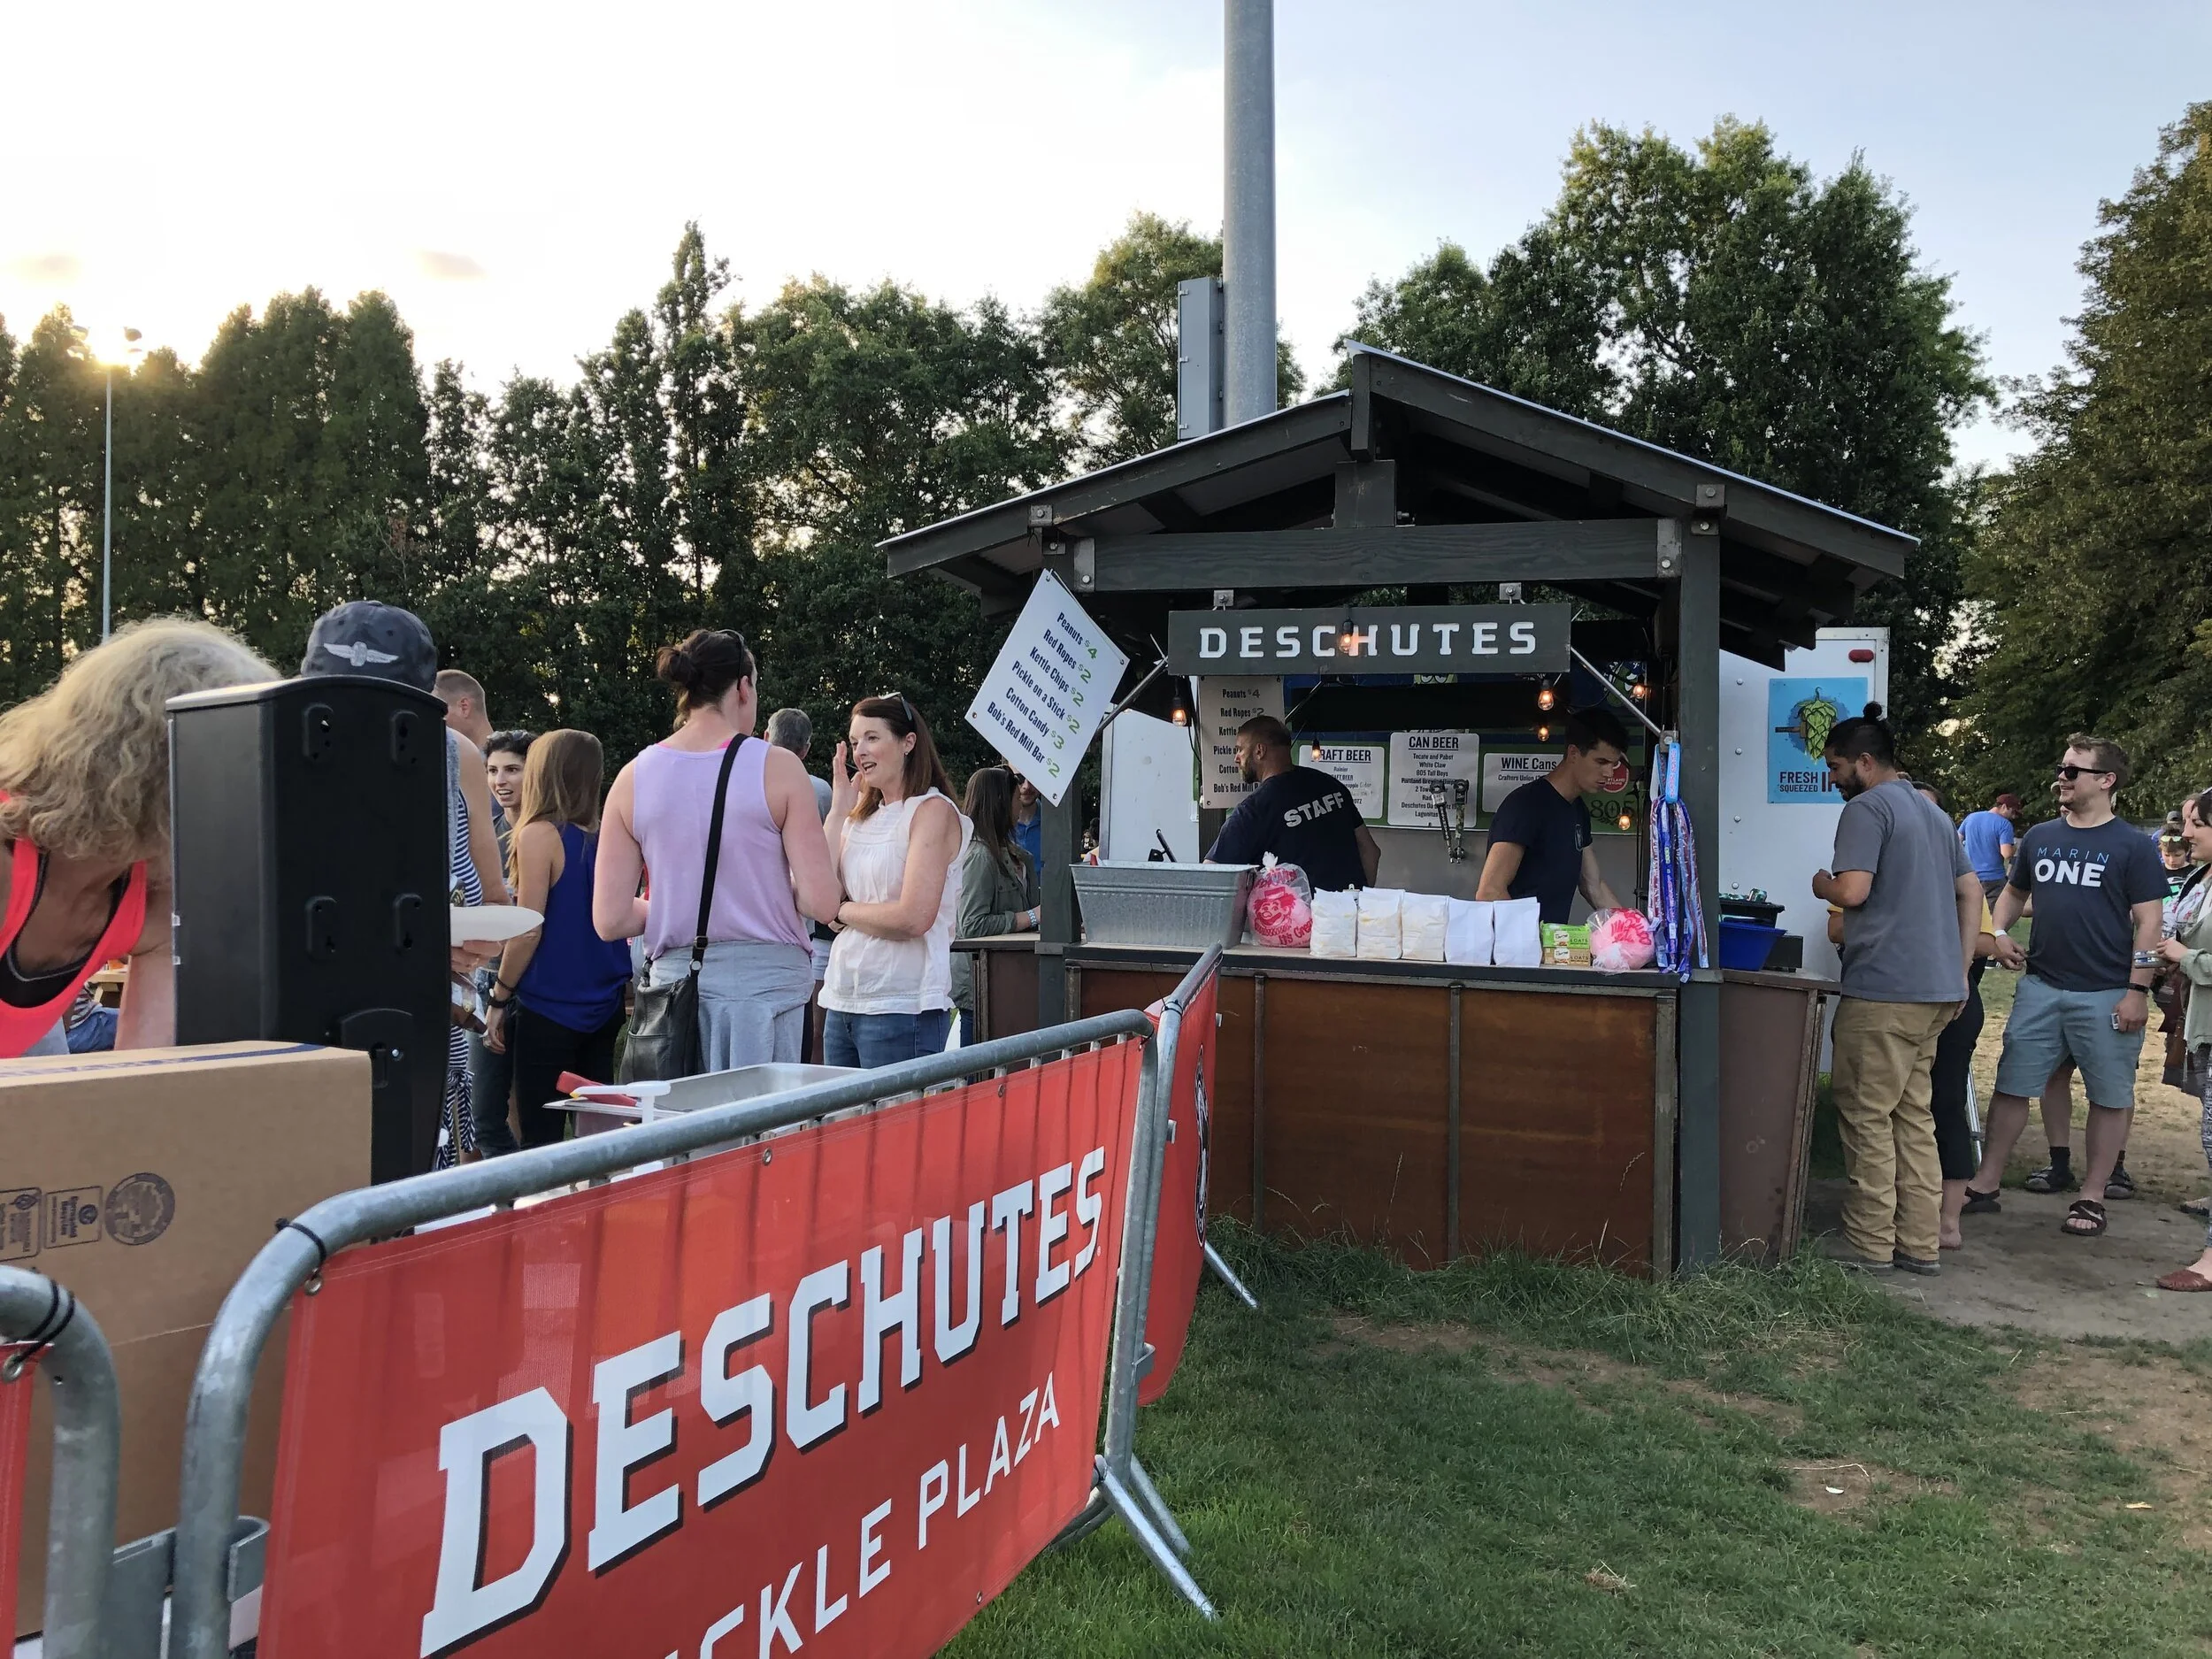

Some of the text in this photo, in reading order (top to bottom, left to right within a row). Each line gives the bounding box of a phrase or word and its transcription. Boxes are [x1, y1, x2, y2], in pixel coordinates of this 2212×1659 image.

[1056, 612, 1098, 660] Peanuts $4
[1198, 621, 1537, 659] DESCHUTES
[1043, 628, 1093, 685] Red Ropes $2
[1029, 647, 1085, 708] Kettle Chips $2
[1011, 660, 1081, 735] Pickle on a Stick $2
[1222, 688, 1247, 699] Peanuts
[1005, 687, 1065, 751] Cotton Candy $3
[1220, 708, 1233, 718] Red
[1233, 708, 1251, 718] Ropes
[987, 702, 1061, 779] Bob's Red Mill Bar $2
[1218, 726, 1237, 736] Kettle
[1409, 736, 1459, 749] CAN BEER
[1213, 746, 1232, 756] Pickle
[1318, 749, 1371, 761] RAFT BEER
[1218, 764, 1239, 774] Cotton
[1502, 757, 1556, 770] WINE Cans
[1213, 783, 1229, 793] Bob's
[1230, 783, 1241, 793] Red
[1242, 783, 1254, 793] Mill
[1779, 771, 1818, 783] FRESH
[1284, 792, 1345, 828] STAFF
[2037, 847, 2109, 864] MARIN
[2034, 858, 2106, 887] ONE
[419, 1146, 1106, 1659] DESCHUTES
[918, 1371, 1060, 1550] PLAZA
